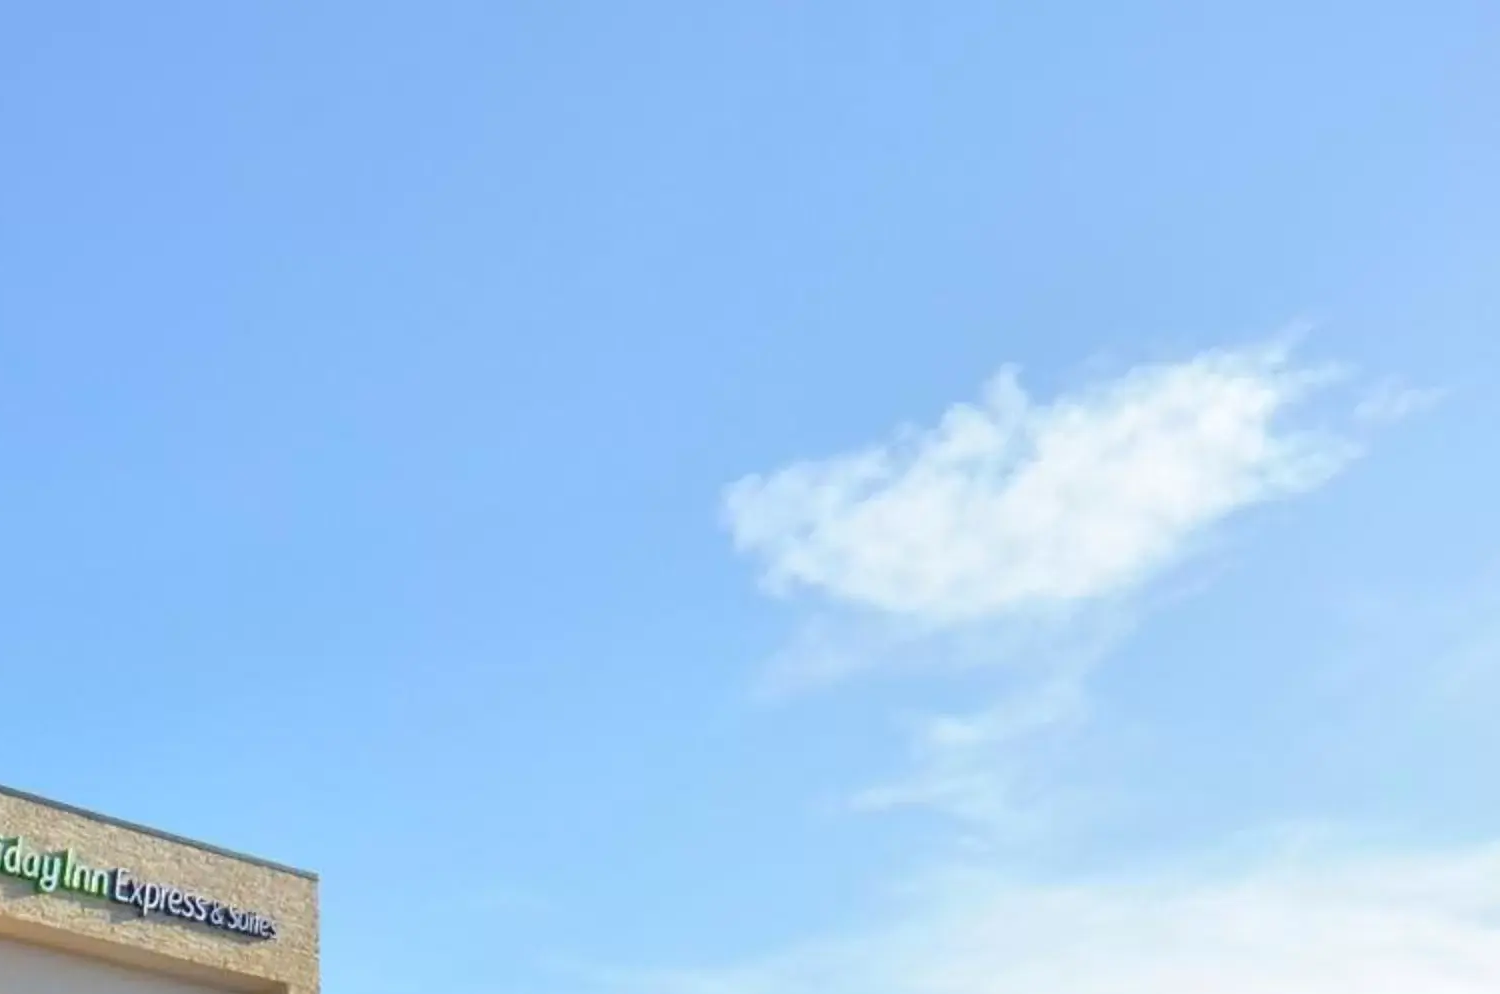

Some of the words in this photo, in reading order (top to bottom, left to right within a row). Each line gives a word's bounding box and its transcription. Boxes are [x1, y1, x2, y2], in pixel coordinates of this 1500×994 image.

[64, 847, 109, 896] Inn
[115, 867, 207, 921] Express
[210, 900, 224, 925] &
[227, 905, 281, 939] Suites
